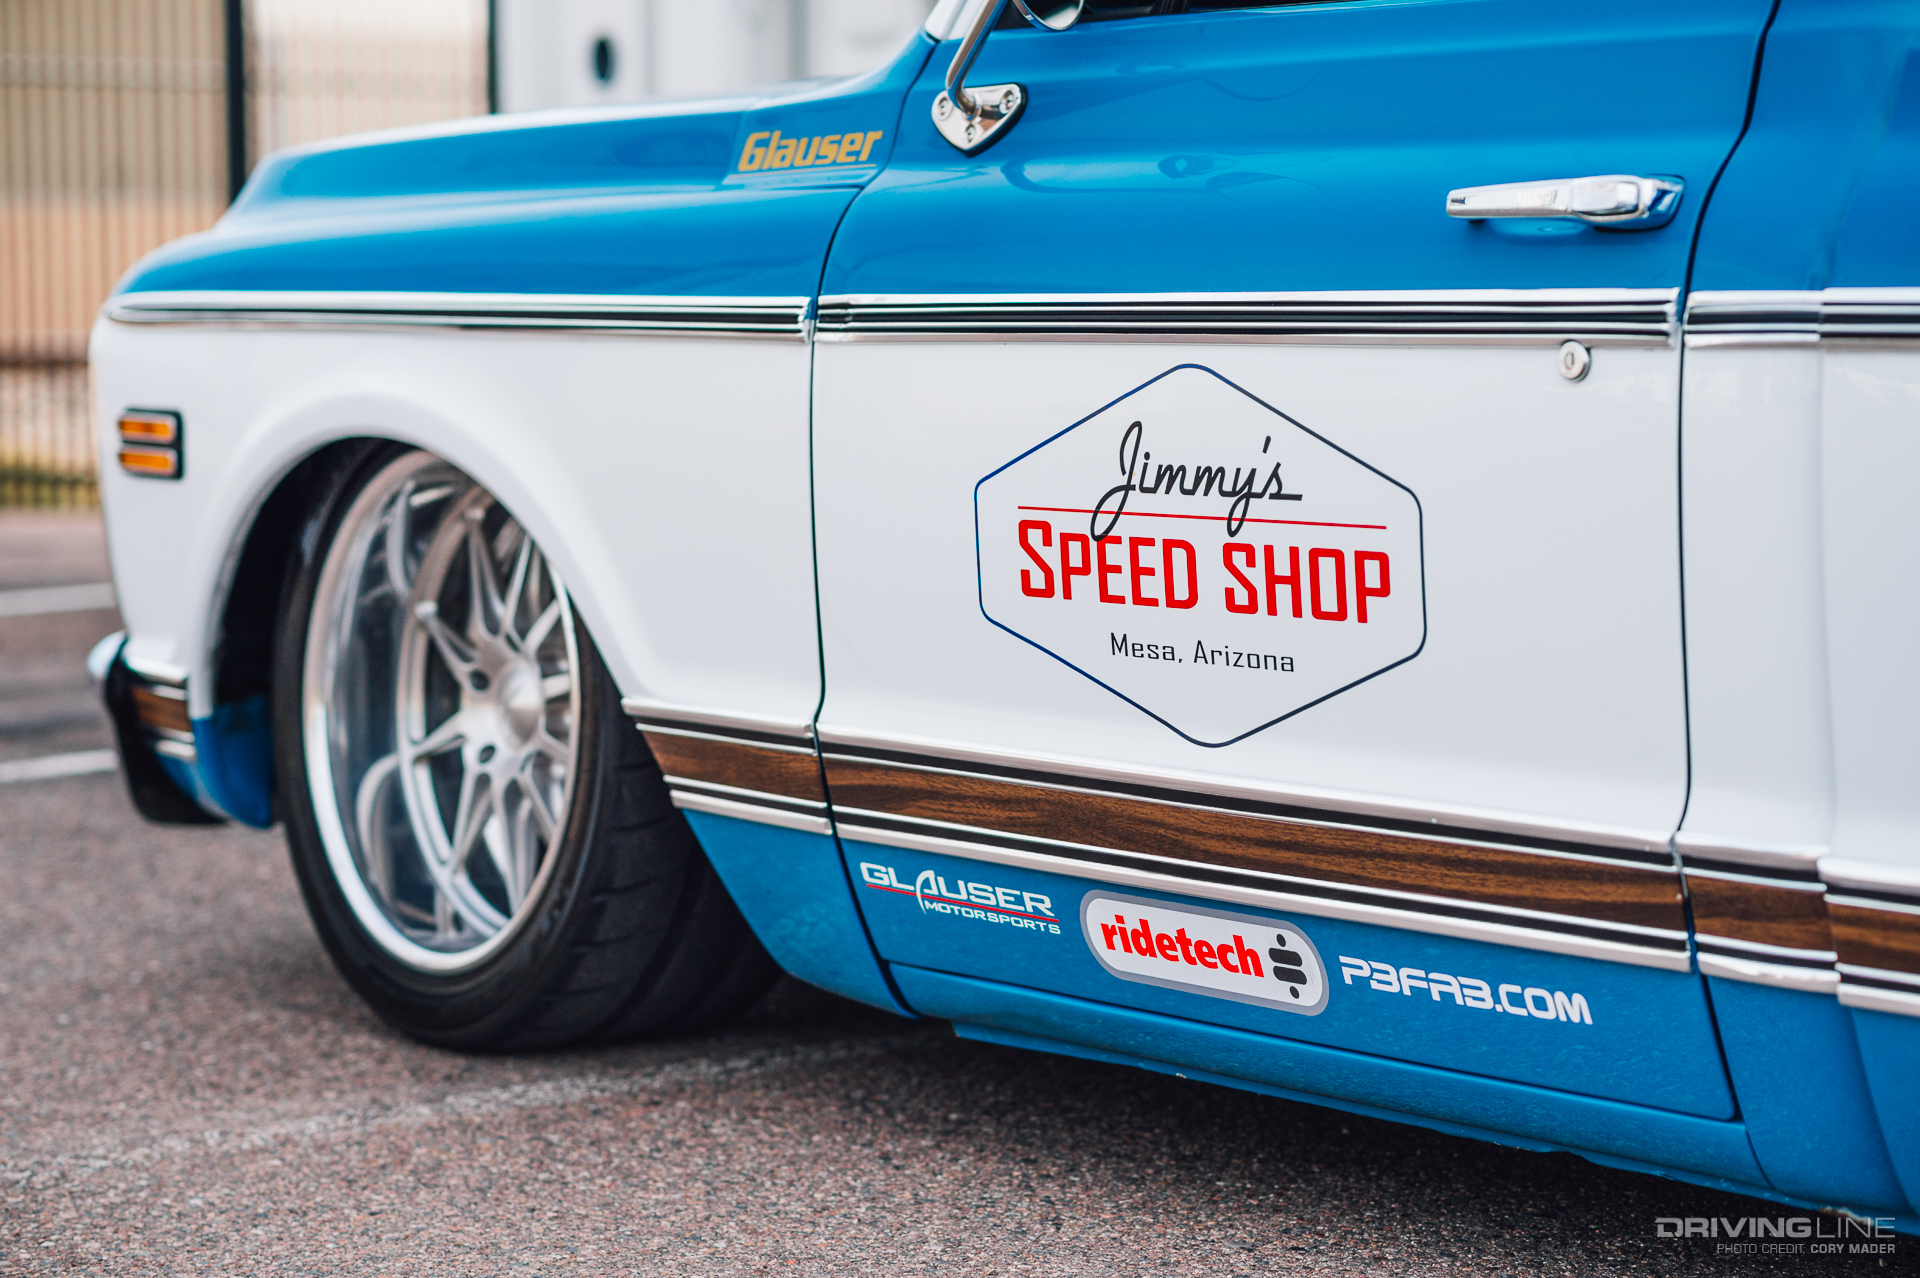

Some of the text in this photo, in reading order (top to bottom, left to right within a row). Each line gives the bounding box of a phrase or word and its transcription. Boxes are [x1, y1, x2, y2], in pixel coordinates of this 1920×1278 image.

[738, 130, 883, 172] Glauser
[1090, 421, 1303, 542] Jimmy's
[1018, 519, 1391, 624] SPEED SHOP
[1110, 632, 1295, 672] Mesa, Arizona
[860, 862, 1056, 917] GLAUSER
[924, 900, 1062, 935] MOTORSPORTS
[1100, 914, 1265, 978] ridetech
